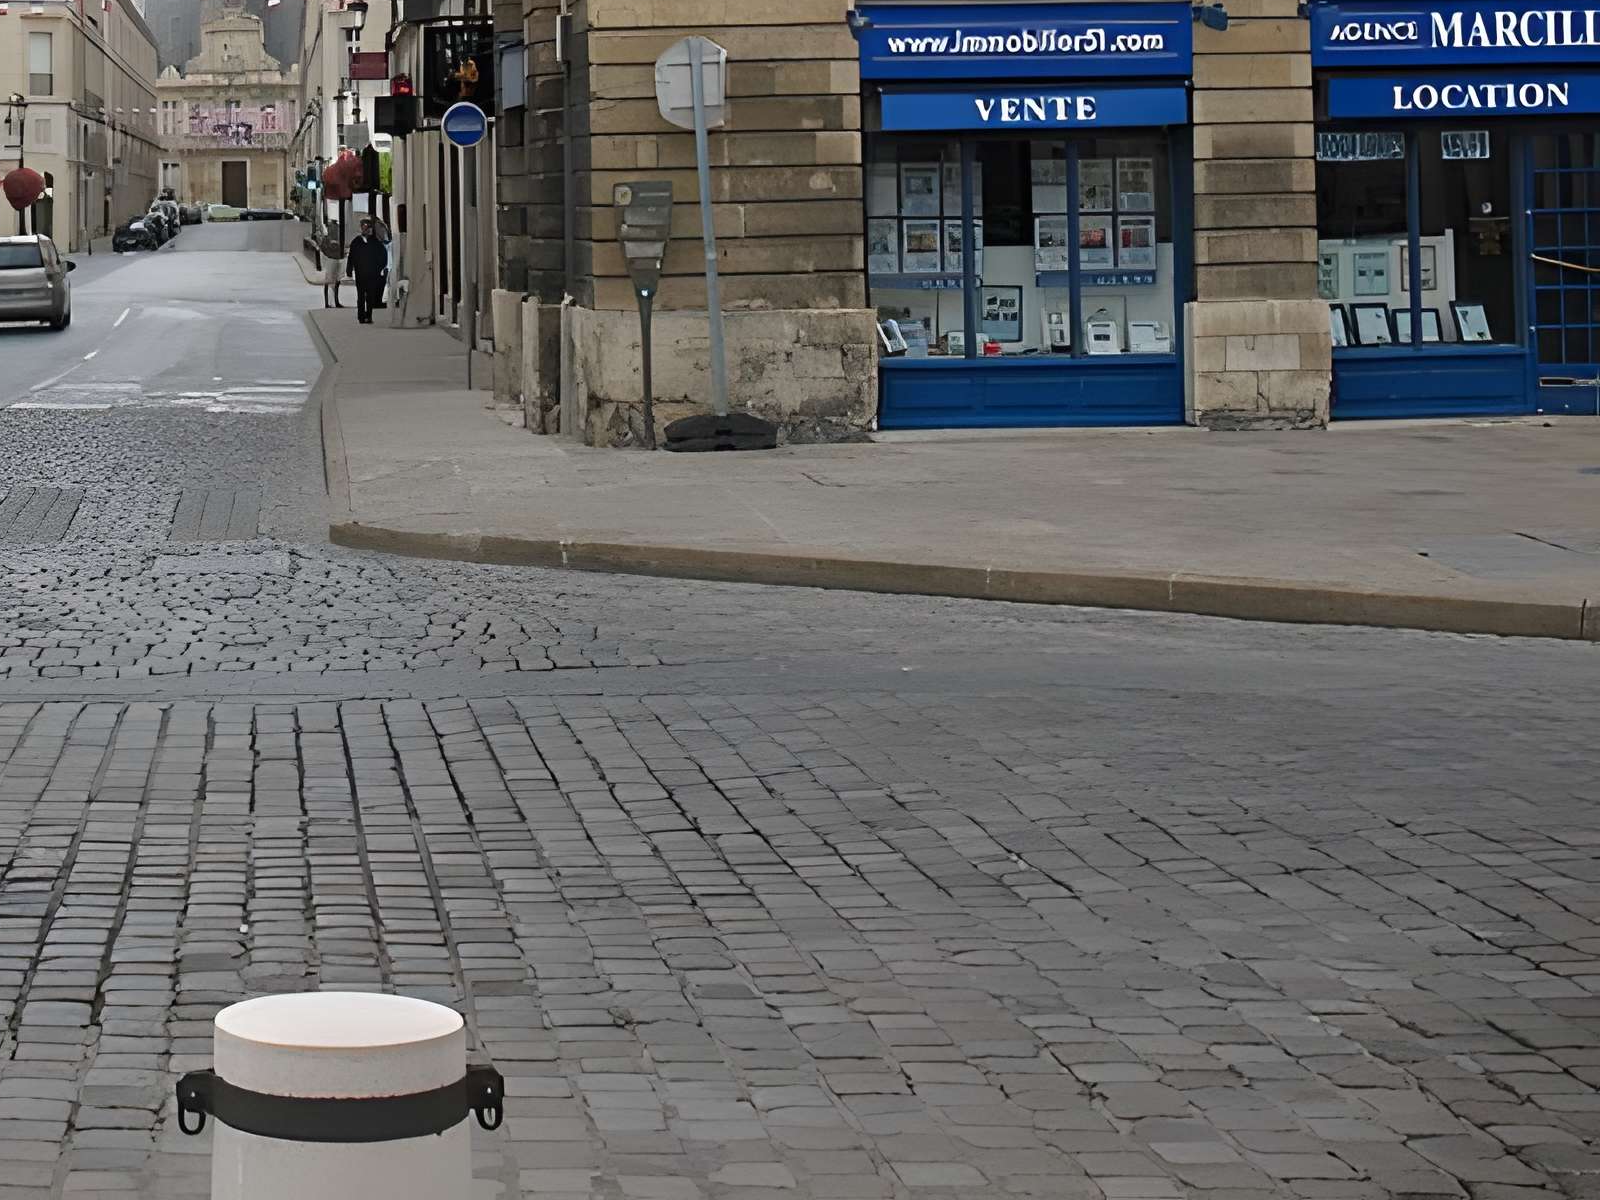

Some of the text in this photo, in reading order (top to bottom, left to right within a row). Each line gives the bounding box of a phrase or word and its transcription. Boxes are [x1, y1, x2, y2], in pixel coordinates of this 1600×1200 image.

[1430, 10, 1600, 48] MARCILL
[974, 96, 1097, 121] VENTE
[1393, 81, 1569, 110] LOCATION
